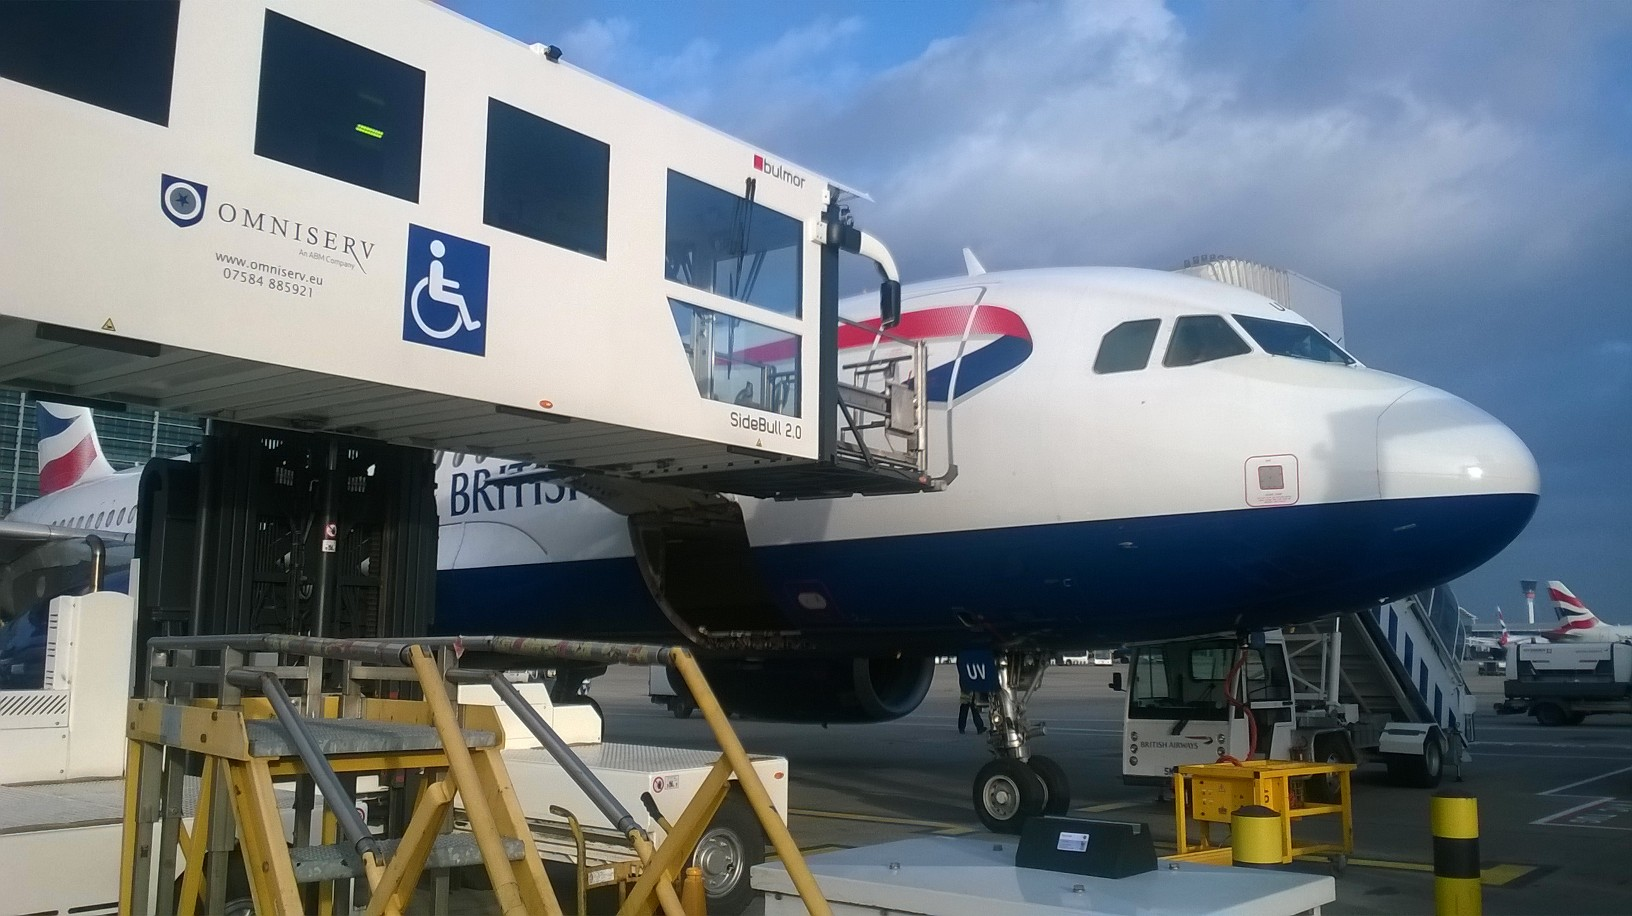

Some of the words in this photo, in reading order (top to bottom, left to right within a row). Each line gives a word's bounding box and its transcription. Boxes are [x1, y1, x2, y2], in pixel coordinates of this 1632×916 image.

[763, 158, 806, 189] bulmor
[217, 202, 376, 275] OMNISERV
[215, 252, 324, 287] www.omniserv.eu
[298, 248, 308, 258] An
[309, 251, 325, 262] ABM
[325, 255, 356, 270] Company
[222, 267, 264, 287] 07584
[267, 278, 314, 298] 885921
[730, 411, 782, 436] SideBull
[785, 423, 802, 440] 2.0
[450, 461, 578, 517] BRITI
[966, 664, 985, 679] UV
[1140, 740, 1168, 749] BRITISH
[1168, 741, 1199, 750] AIRWAYS
